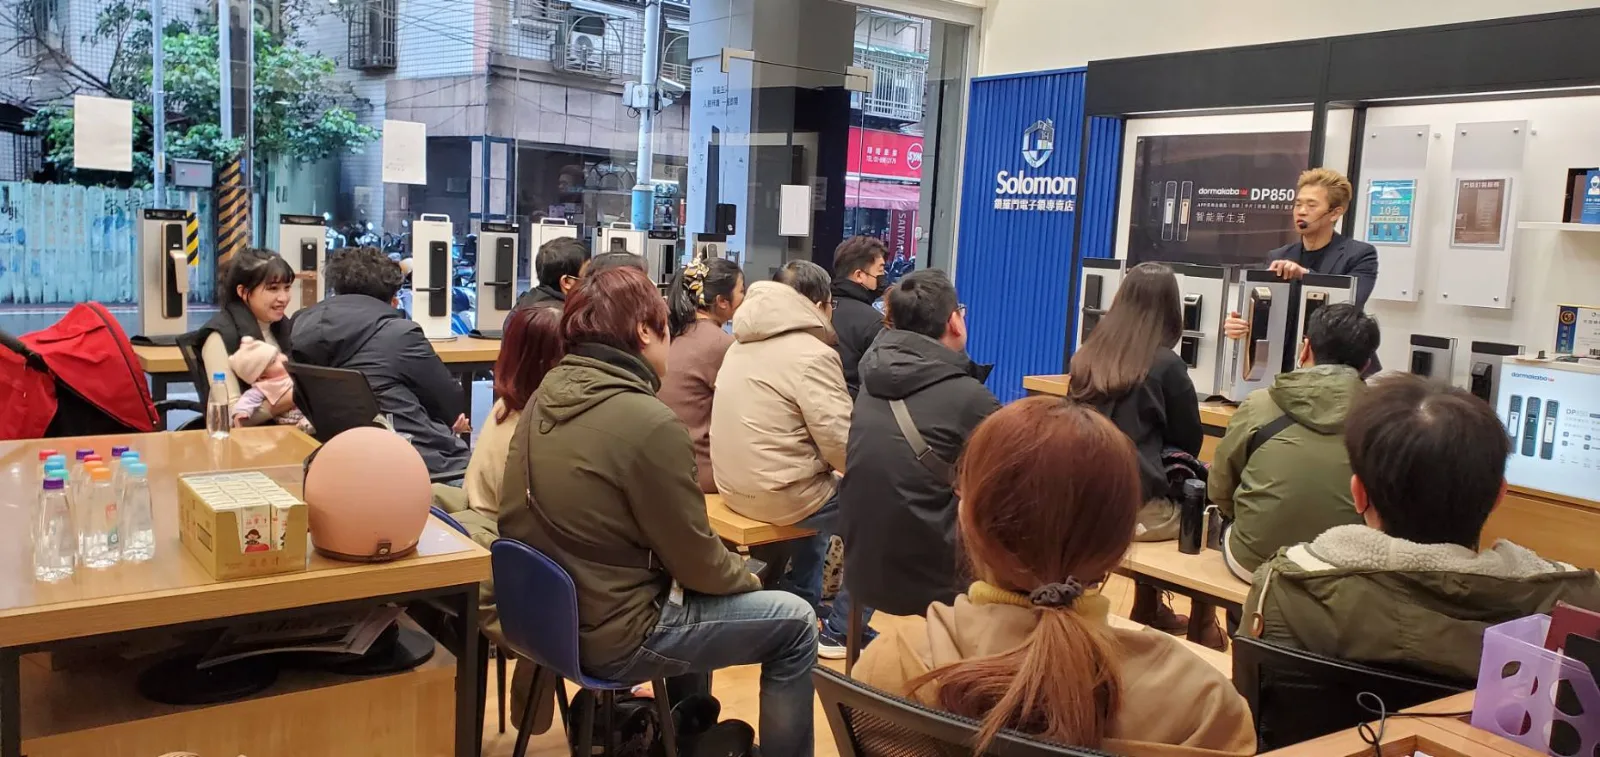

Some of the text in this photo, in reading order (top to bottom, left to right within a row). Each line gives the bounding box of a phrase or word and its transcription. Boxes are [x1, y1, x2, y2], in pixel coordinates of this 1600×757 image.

[995, 170, 1077, 195] Solomon
[1198, 187, 1295, 201] dormakaba DP850
[1195, 211, 1246, 224] 智能新生活
